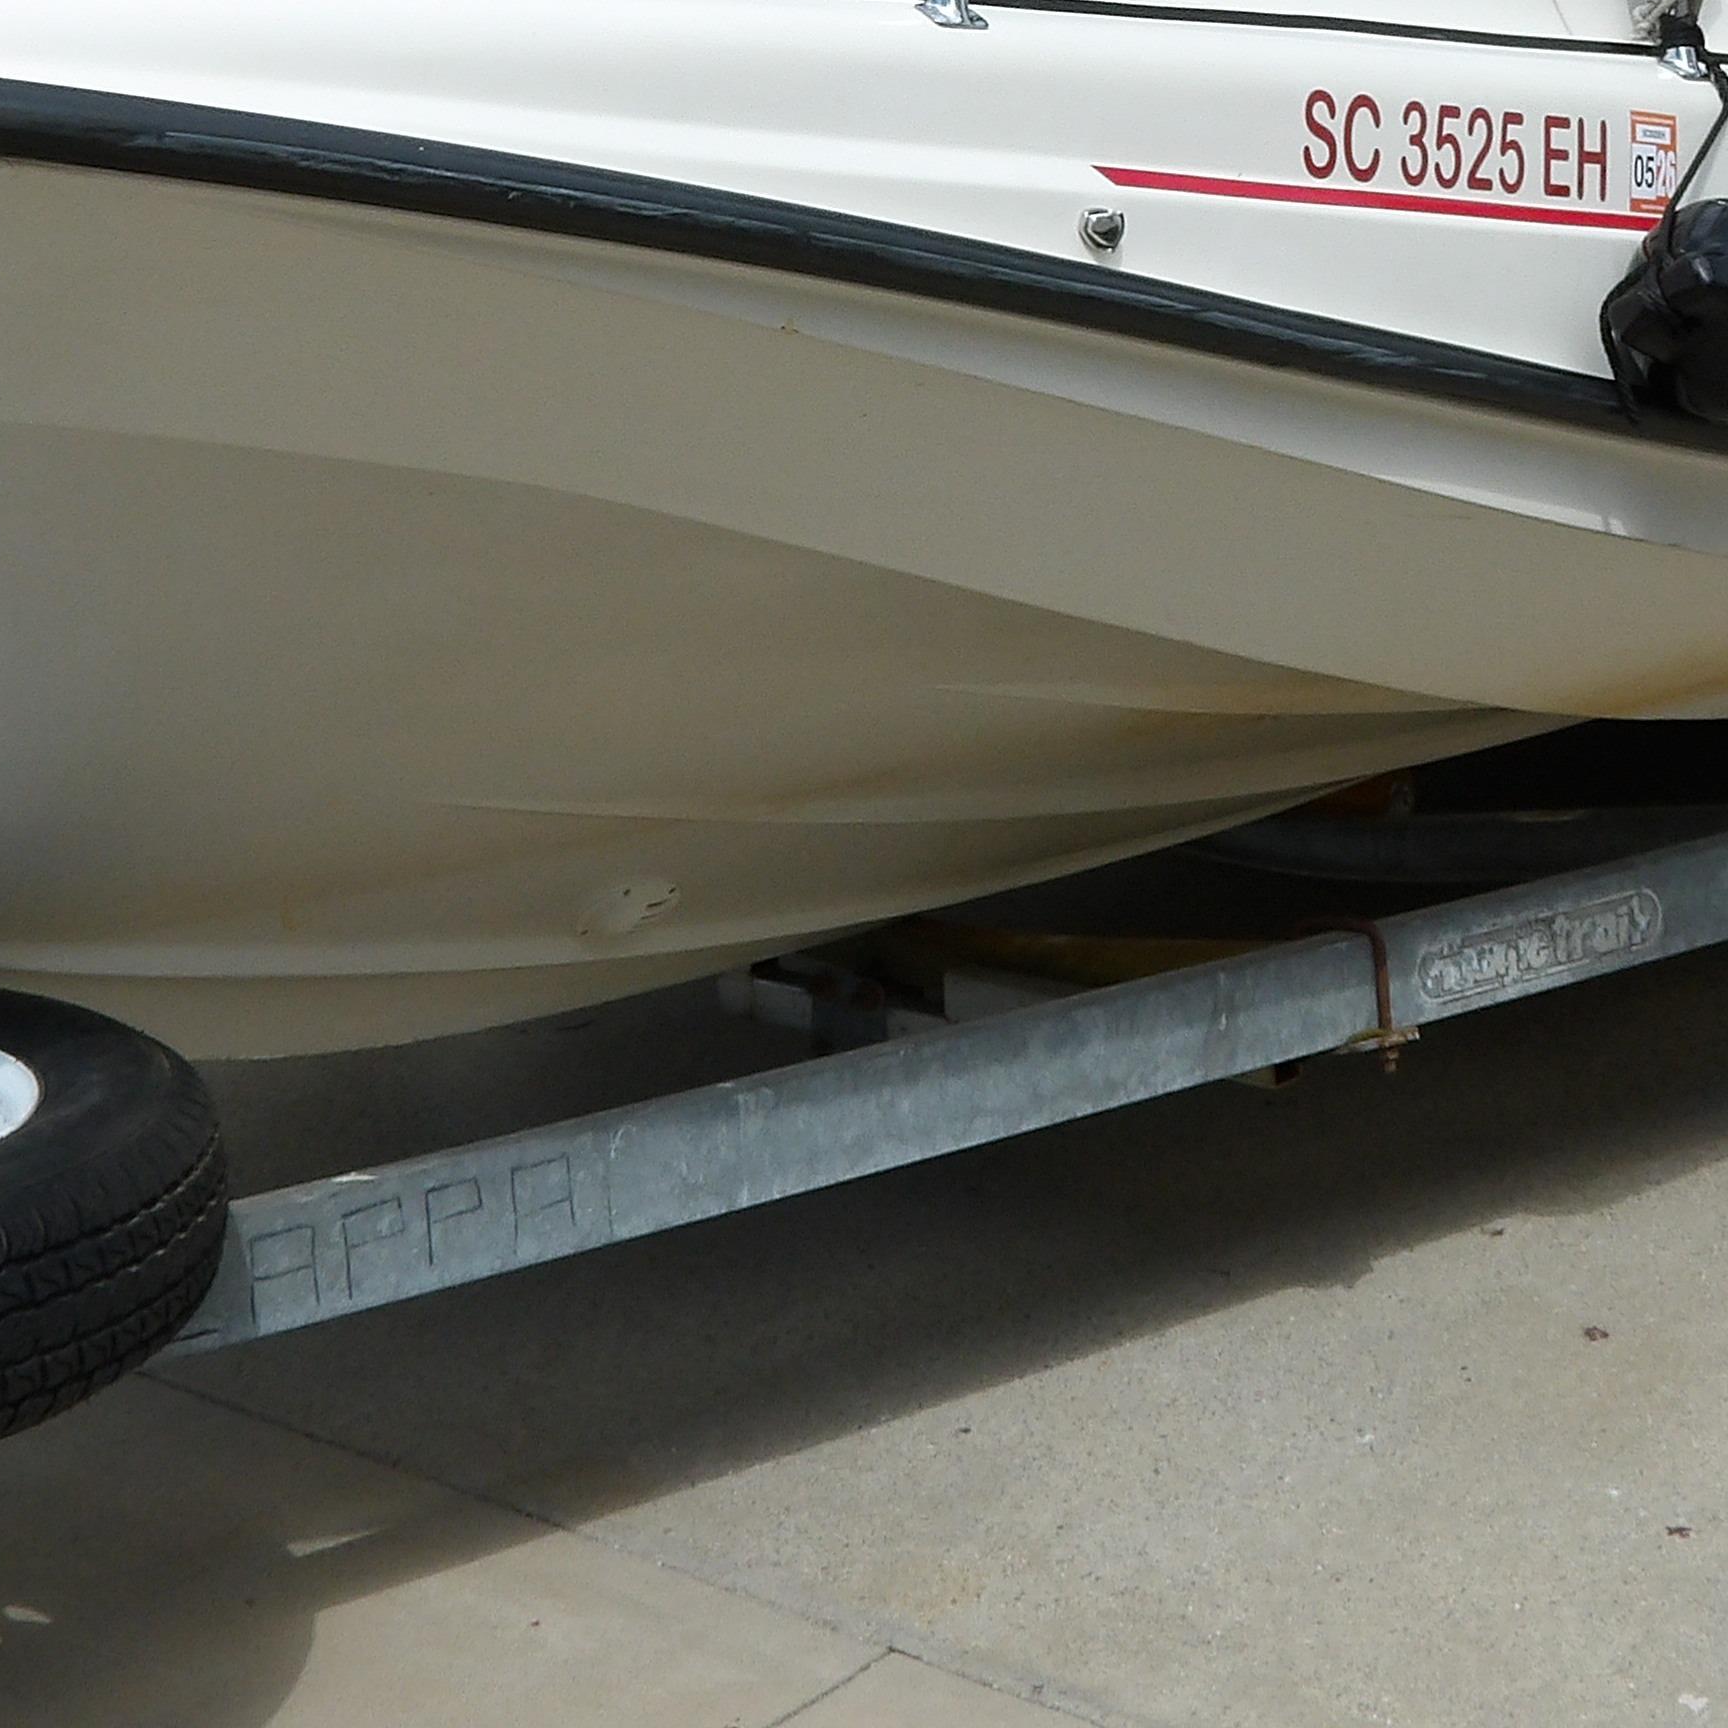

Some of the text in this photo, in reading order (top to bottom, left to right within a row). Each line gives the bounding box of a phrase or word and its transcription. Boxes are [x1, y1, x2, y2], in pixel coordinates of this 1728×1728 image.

[1303, 89, 1608, 202] SC 3525 EH
[1634, 154, 1655, 189] 05
